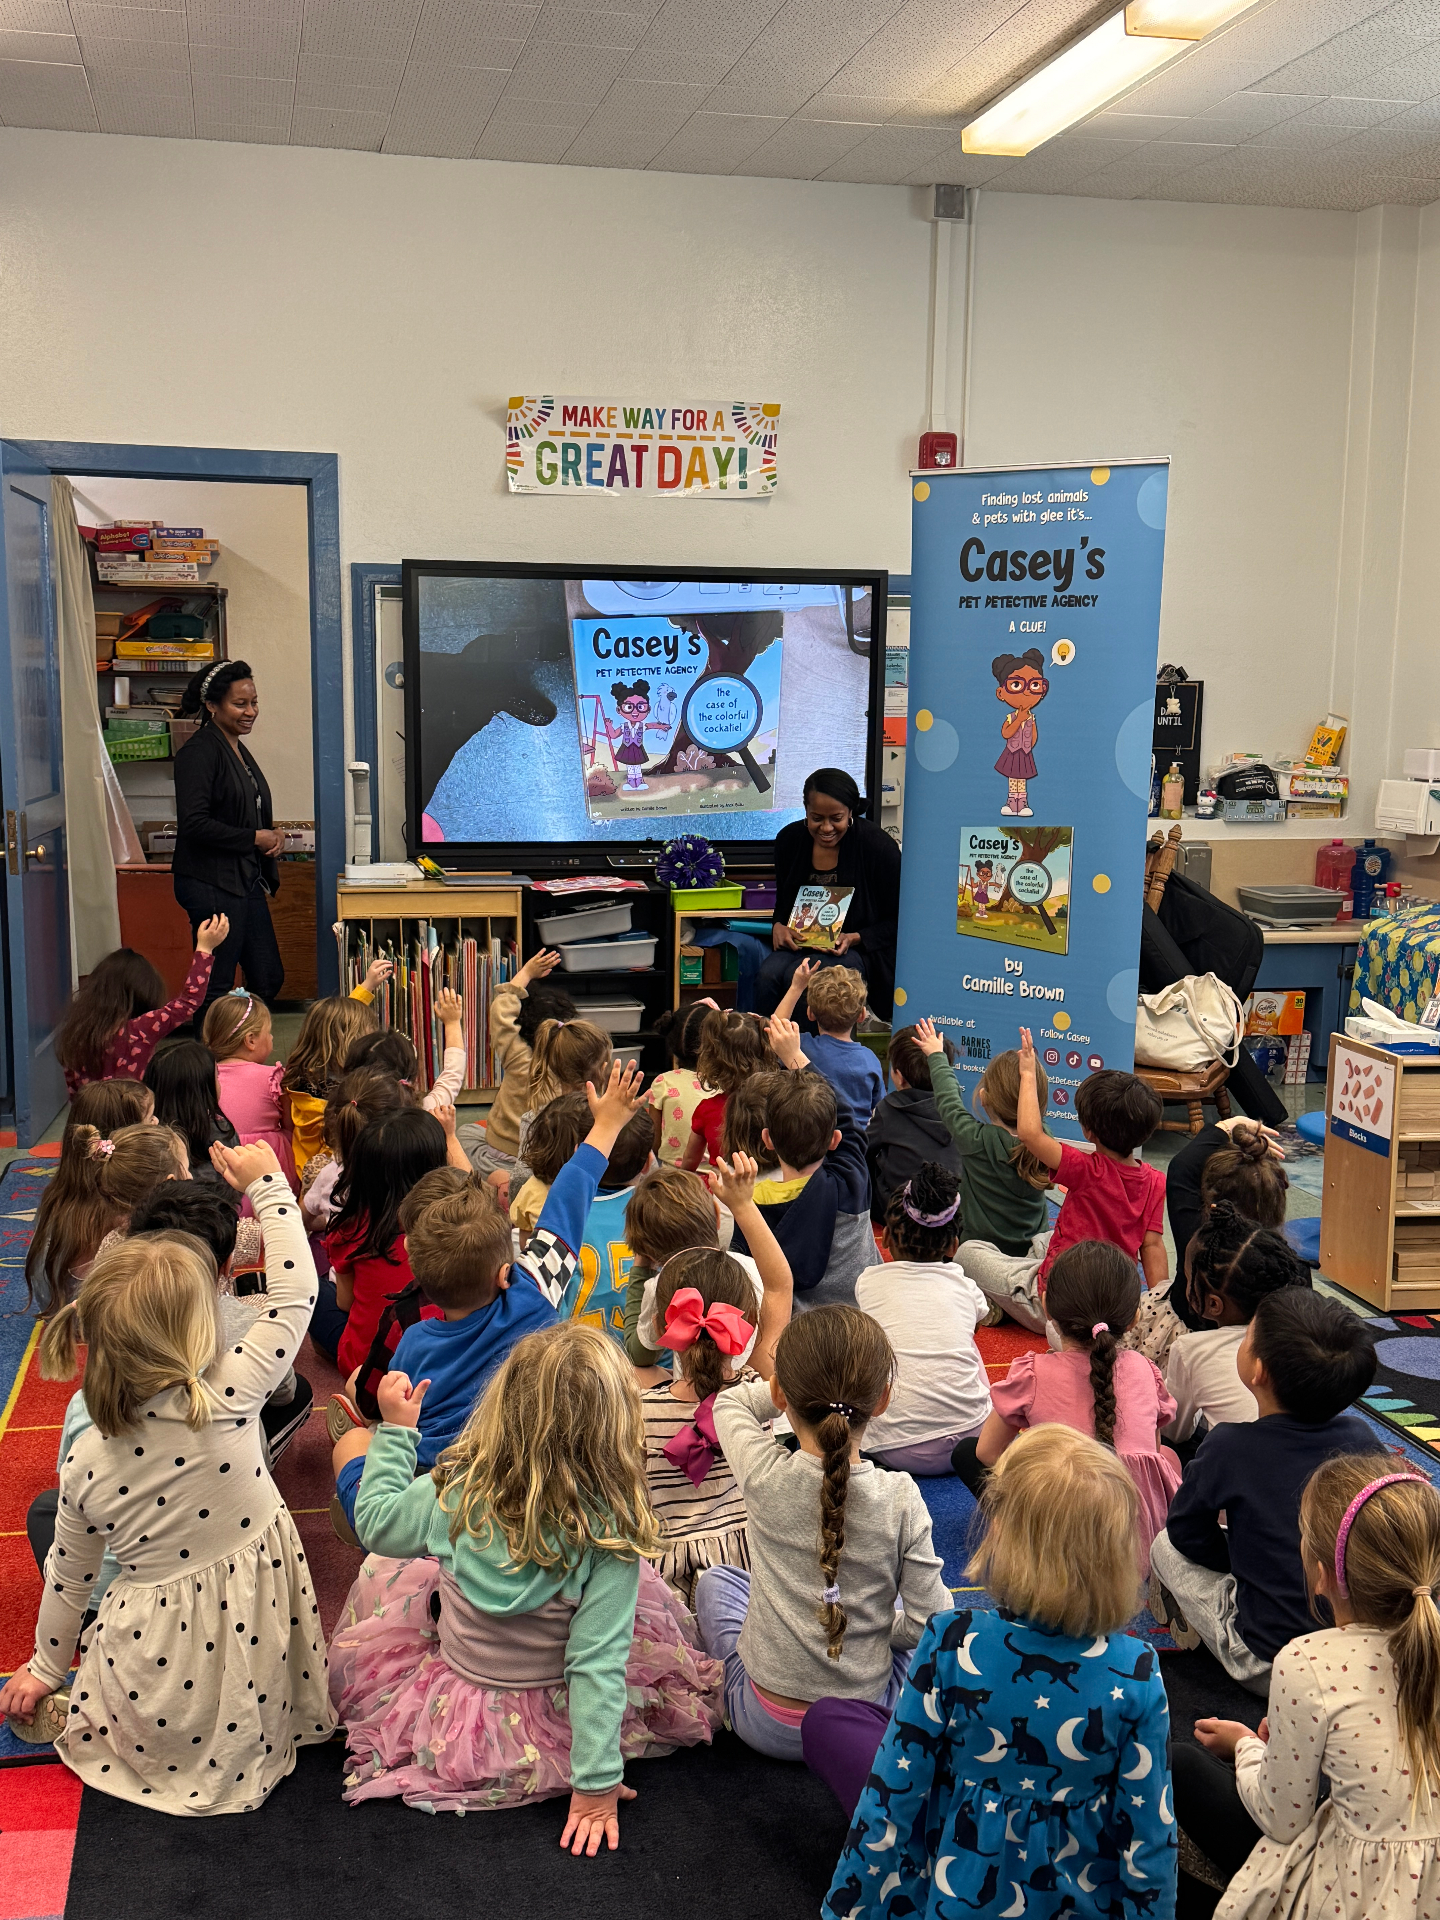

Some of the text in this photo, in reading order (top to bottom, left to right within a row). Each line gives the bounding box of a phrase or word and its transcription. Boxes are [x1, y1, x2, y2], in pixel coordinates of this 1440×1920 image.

[562, 405, 725, 432] MAKE WAY FOR A
[536, 441, 748, 490] GREAT DAY!
[981, 489, 1089, 507] Finding lost animals
[971, 512, 981, 525] &
[984, 511, 1009, 528] pets
[1012, 509, 1037, 523] with
[1040, 508, 1064, 525] glee
[959, 536, 1106, 593] Casey's
[959, 594, 1099, 608] PET DETECTIVE AGENCY
[1009, 620, 1047, 633] A CLUE!
[593, 627, 701, 664] Casey's
[596, 665, 699, 678] PET DETECTIVE AGENCY
[717, 687, 731, 697] the
[705, 699, 738, 709] case of
[699, 710, 749, 721] the colorful
[1157, 716, 1183, 726] UNTIL
[704, 722, 742, 733] cockatiel
[969, 834, 1020, 854] Casey's
[802, 887, 830, 899] Casey's
[1004, 957, 1023, 977] by
[962, 974, 1065, 1003] Camille Brown
[965, 1019, 976, 1029] at
[961, 1035, 991, 1050] BARNES
[1040, 1028, 1091, 1045] Follow Casey
[967, 1046, 992, 1060] NOBLE
[962, 1063, 987, 1074] bookst
[1348, 1127, 1367, 1143] Blocks
[569, 1240, 635, 1333] 25
